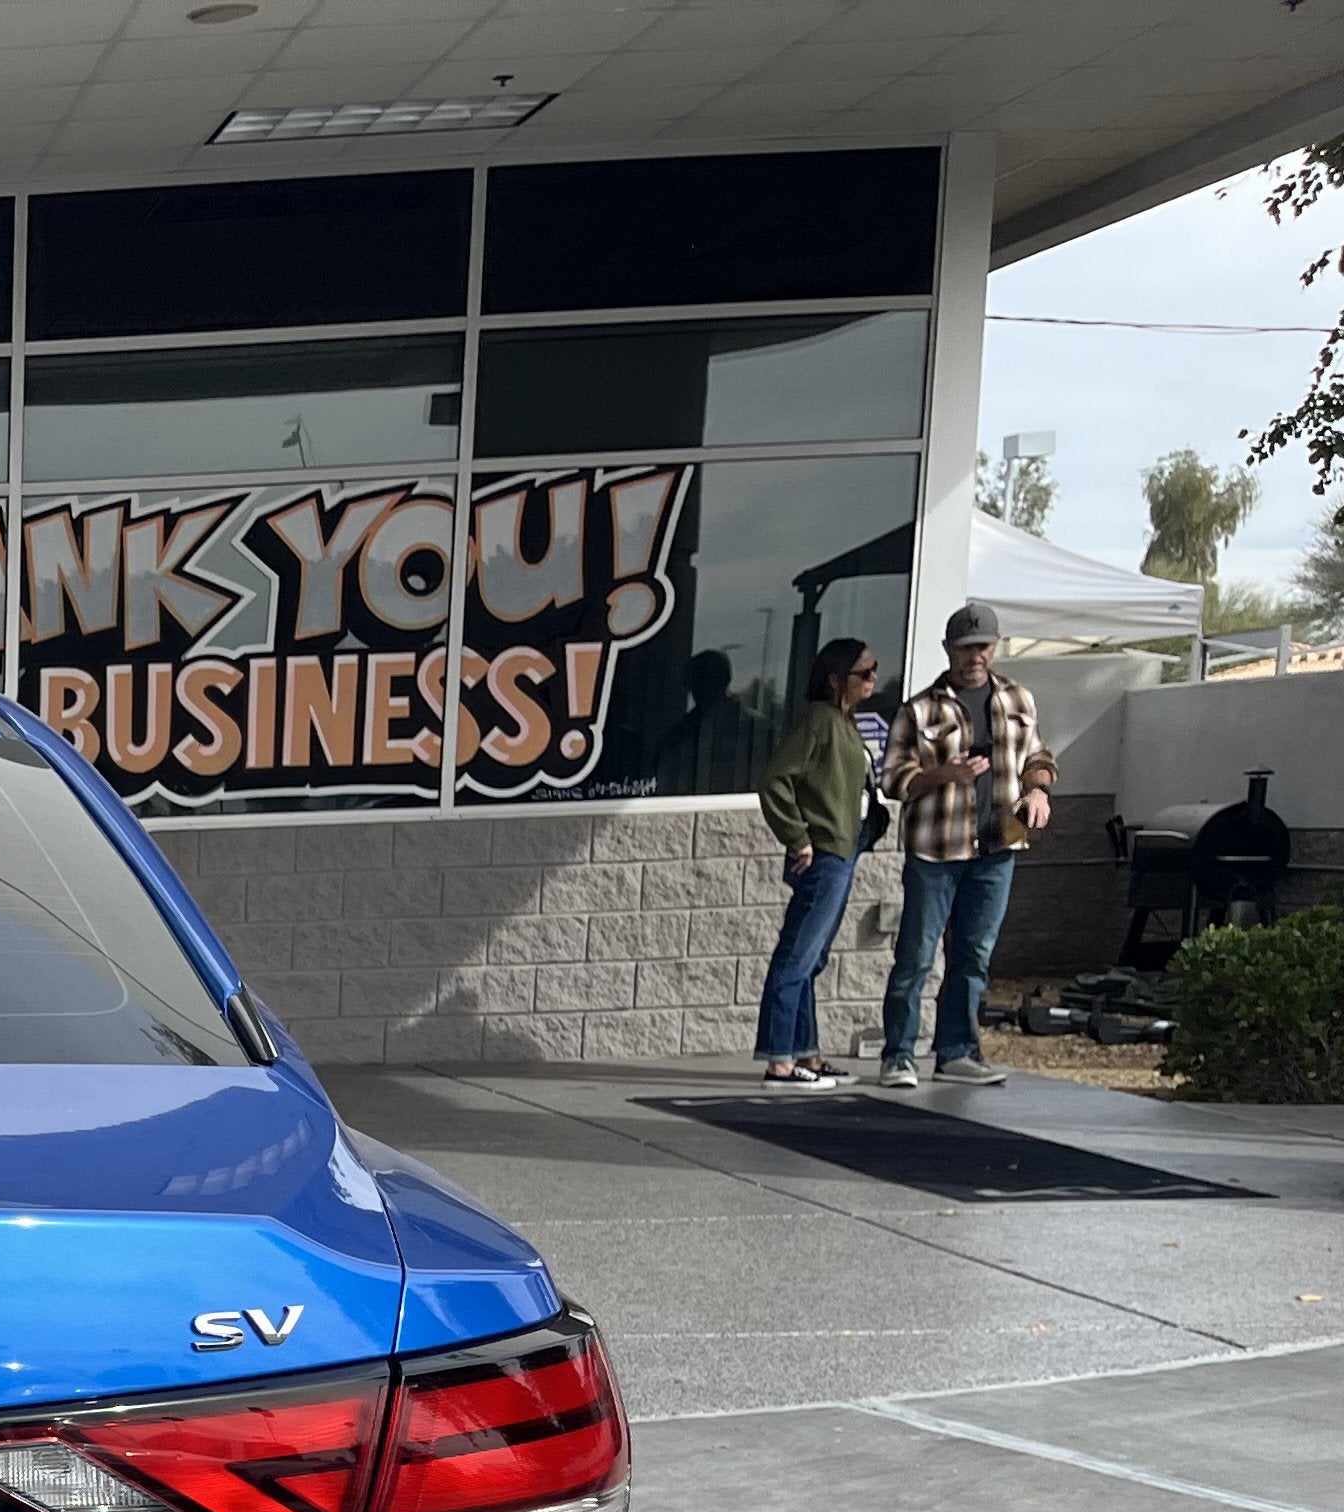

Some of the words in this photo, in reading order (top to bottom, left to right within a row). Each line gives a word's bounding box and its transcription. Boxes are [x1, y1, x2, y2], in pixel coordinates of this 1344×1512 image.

[267, 472, 676, 638] YOU!
[40, 642, 603, 777] BUSINESS!
[190, 1304, 305, 1353] SV
